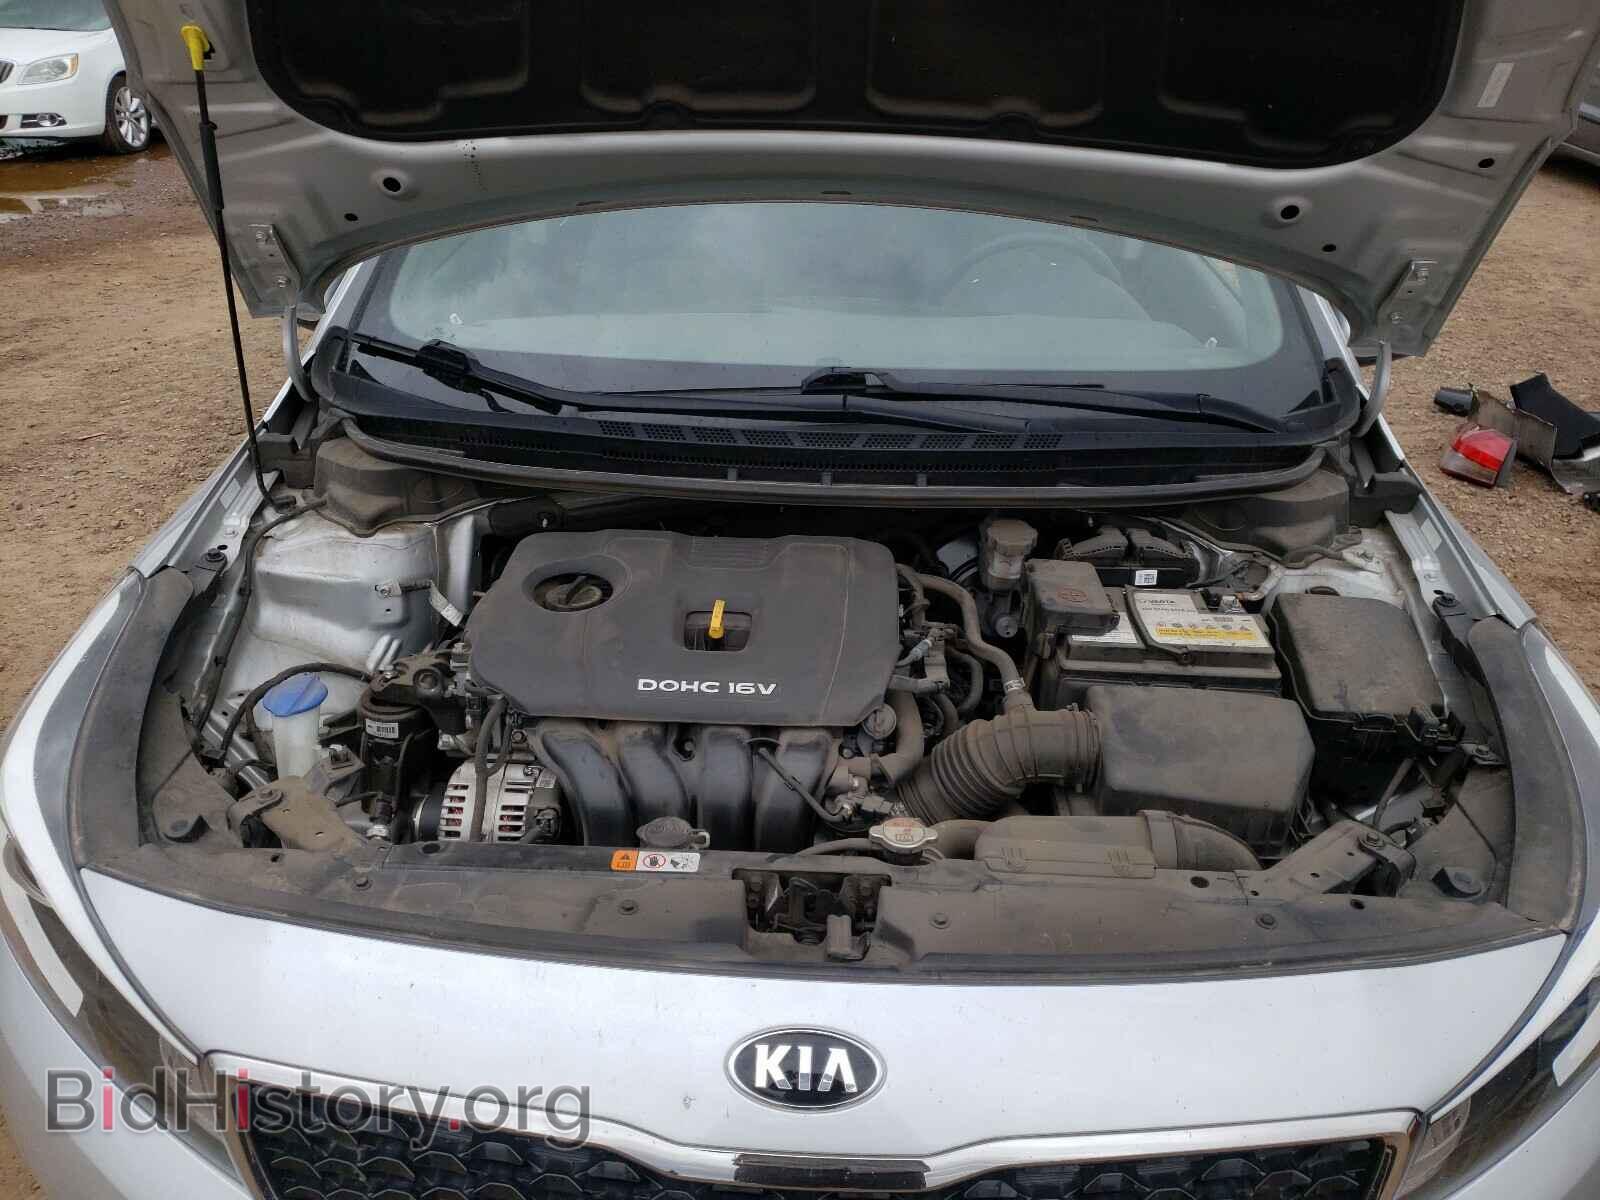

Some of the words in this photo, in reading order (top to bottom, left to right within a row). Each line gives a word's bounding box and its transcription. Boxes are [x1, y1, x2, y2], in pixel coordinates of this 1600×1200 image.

[637, 678, 721, 693] DOHC
[728, 682, 777, 695] 16V
[754, 1044, 858, 1093] KIA
